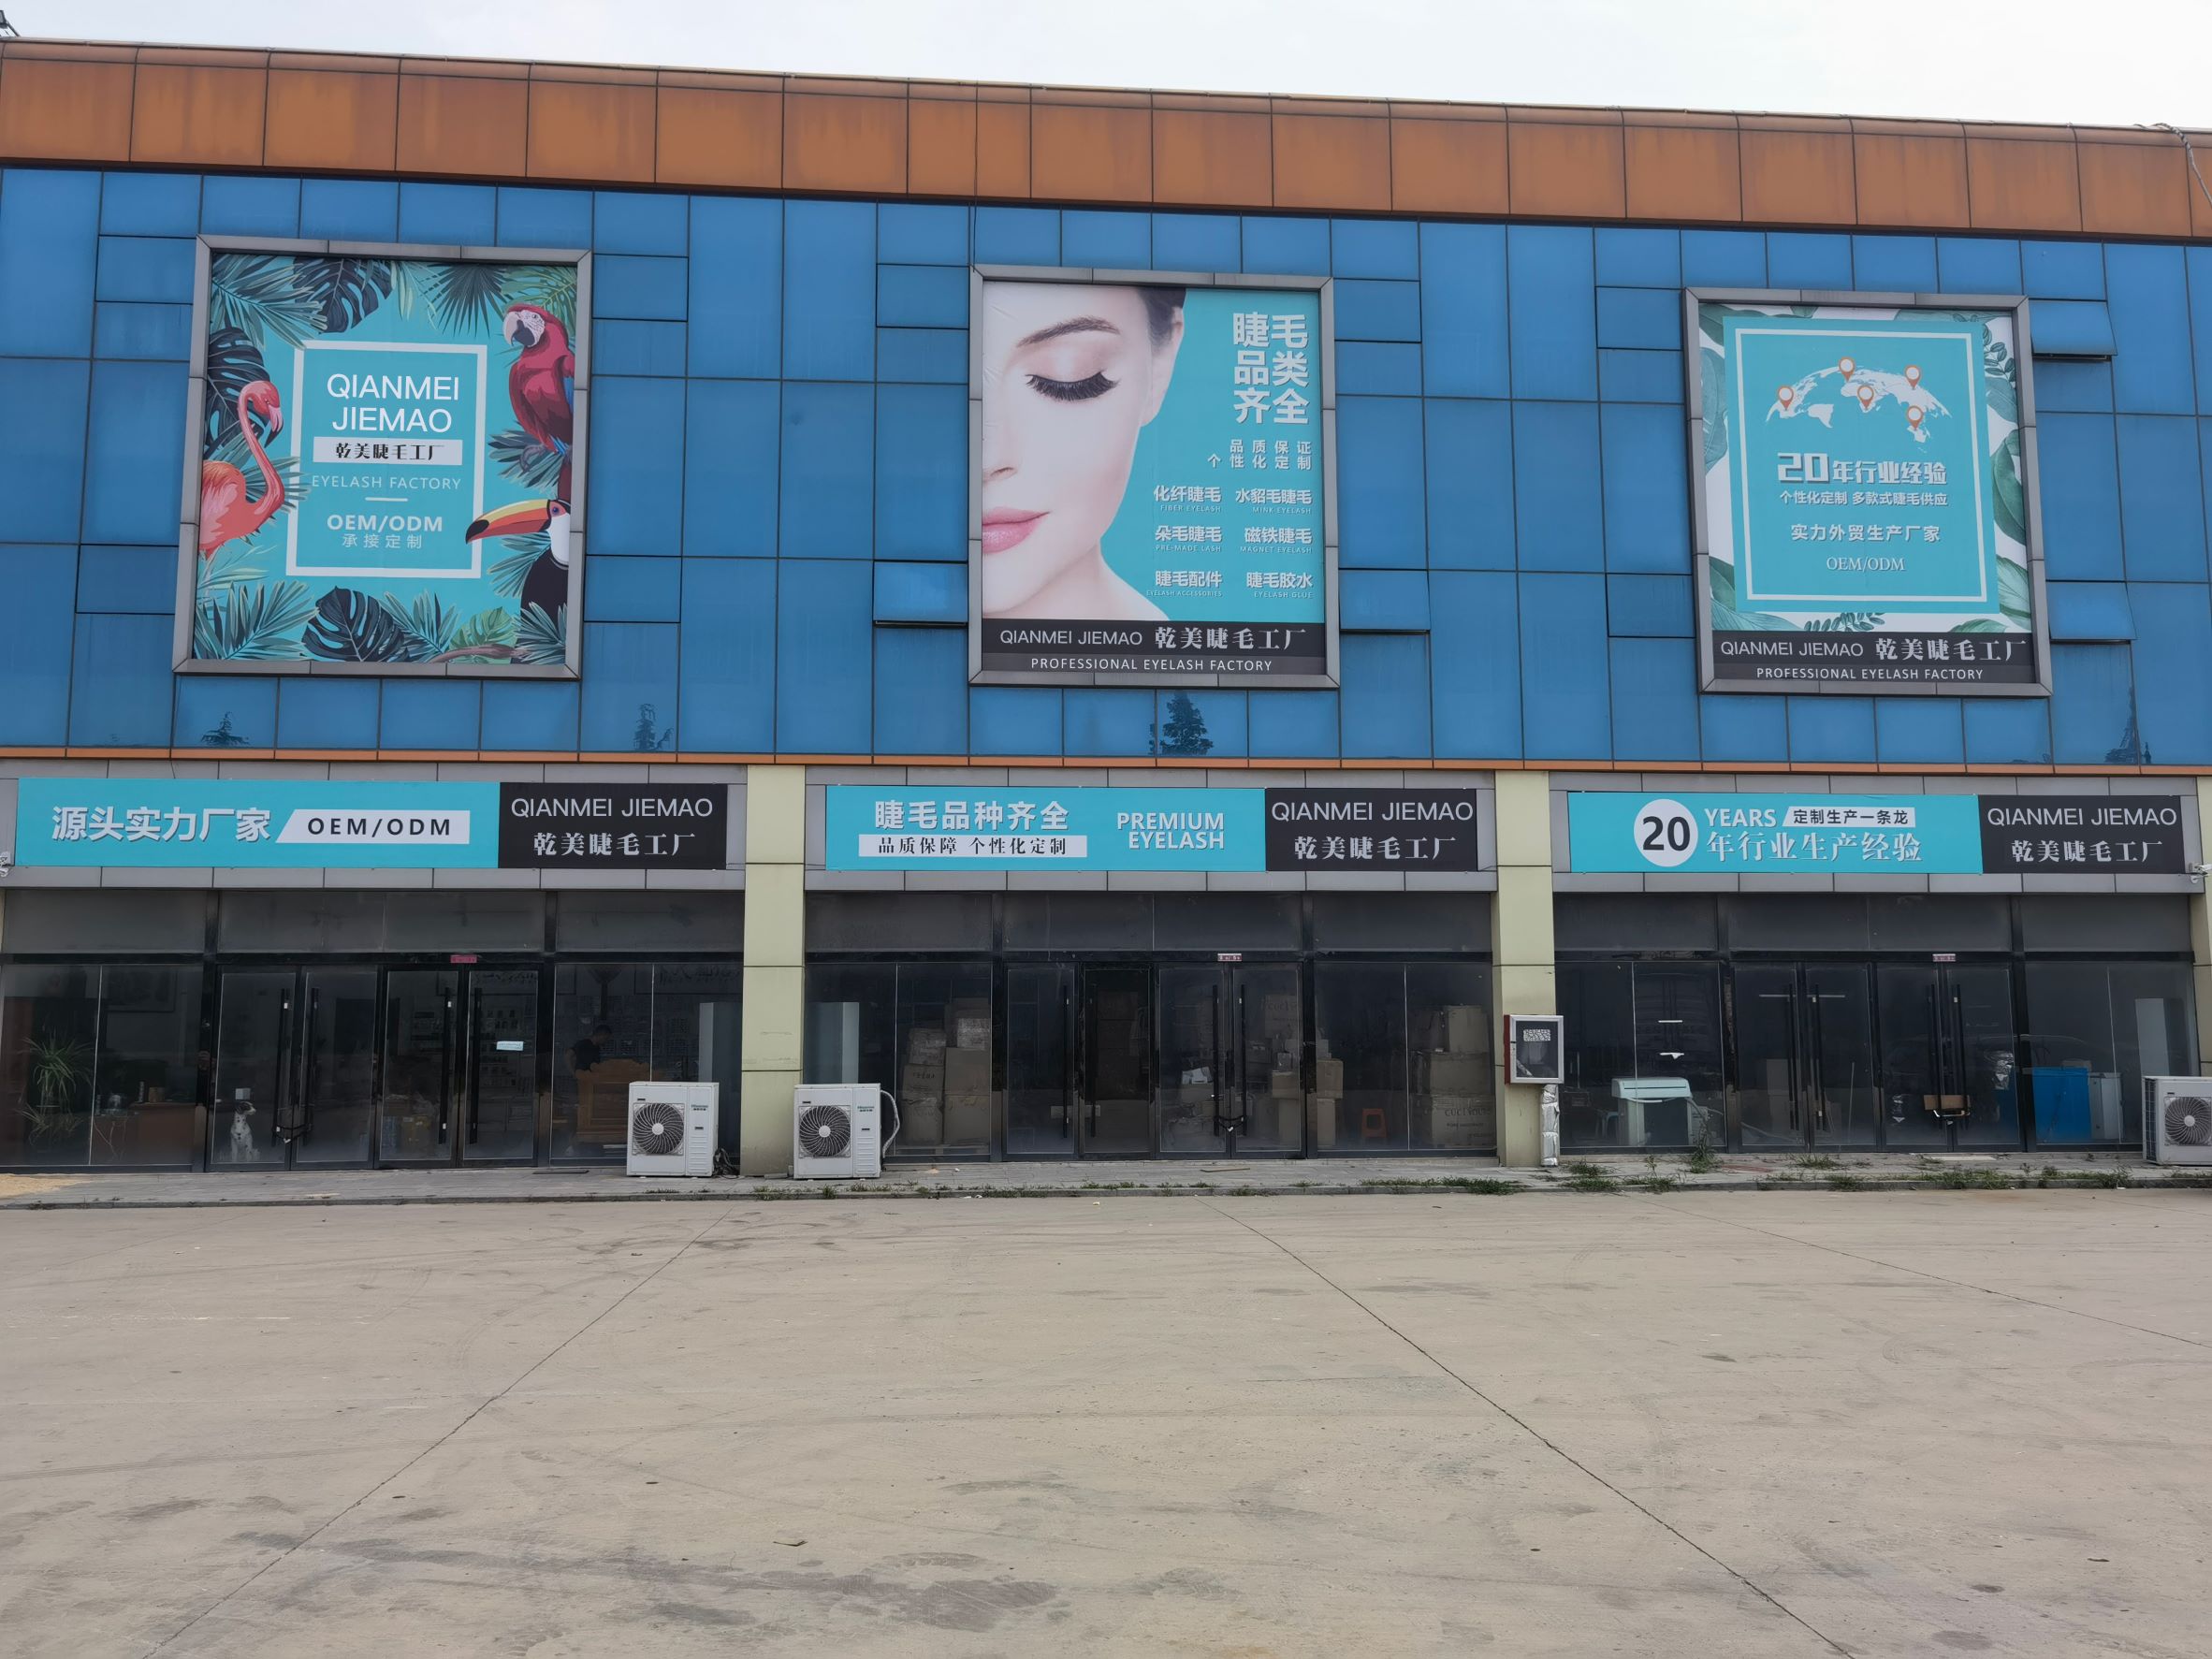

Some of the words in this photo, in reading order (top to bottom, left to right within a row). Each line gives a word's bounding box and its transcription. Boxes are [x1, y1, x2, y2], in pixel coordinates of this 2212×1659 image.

[1232, 312, 1309, 349] 睫毛
[1233, 350, 1309, 386] 品类
[327, 373, 458, 400] QIANMEI
[1233, 387, 1310, 425] 齐全
[332, 406, 452, 432] JIEMAO
[336, 443, 444, 460] 乾美睫毛工厂
[1230, 439, 1311, 455] 品质保证
[1208, 453, 1312, 471] 个性化定制
[1777, 452, 1947, 485] 20年行业经验
[312, 475, 382, 488] EYELASH
[390, 477, 461, 489] FACTORY
[1153, 485, 1221, 502] 化纤睫毛
[1235, 488, 1312, 504] 水貂毛睫毛
[1780, 490, 1848, 505] 个性化定制
[1853, 491, 1948, 506] 多款式睫毛供应
[327, 515, 443, 532] OEM/ODM
[342, 533, 422, 549] 承接定制
[1155, 525, 1222, 543] 朵毛睫毛
[1244, 527, 1312, 544] 磁铁睫毛
[1791, 524, 1941, 543] 实力外贸生产厂家
[1826, 557, 1905, 573] OEM/ODM
[1156, 571, 1223, 588] 睫毛配件
[1246, 572, 1313, 589] 睫毛胶水
[999, 630, 1072, 646] QIANMEI
[1078, 630, 1142, 646] JIEMAO
[1155, 627, 1306, 650] 乾美睫毛工厂
[1721, 641, 1793, 657] QIANMEI
[1799, 642, 1864, 657] JIEMAO
[1875, 638, 2028, 662] 乾美睫毛工厂
[1031, 658, 1138, 670] PROFESSIONAL
[1143, 659, 1203, 671] EYELASH
[1210, 660, 1273, 672] FACTORY
[1756, 667, 1856, 679] PROFESSIONAL
[1861, 668, 1918, 680] EYELASH
[1924, 668, 1984, 680] FACTORY
[511, 798, 612, 818] QIANMEI
[621, 798, 713, 817] JIEMAO
[875, 800, 1070, 831] 睫毛品种齐全
[1272, 802, 1372, 822] QIANMEI
[1382, 802, 1473, 821] JIEMAO
[1793, 809, 1909, 825] 定制生产一条龙
[1987, 808, 2083, 826] QIANMEI
[2091, 808, 2177, 826] JIEMAO
[51, 805, 271, 843] 源头实力厂家
[307, 817, 451, 838] OEM/ODM
[1117, 812, 1225, 831] PREMIUM
[1642, 816, 1691, 851] 20
[1704, 808, 1777, 828] YEARS
[533, 832, 695, 856] 乾美睫毛工厂
[879, 837, 957, 854] 品质保障
[968, 837, 1068, 855] 个性化定制
[1128, 832, 1225, 850] EYELASH
[1294, 837, 1456, 860] 乾美睫毛工厂
[1707, 831, 1922, 863] 年行业生产经验
[2012, 840, 2162, 863] 乾美睫毛工厂
